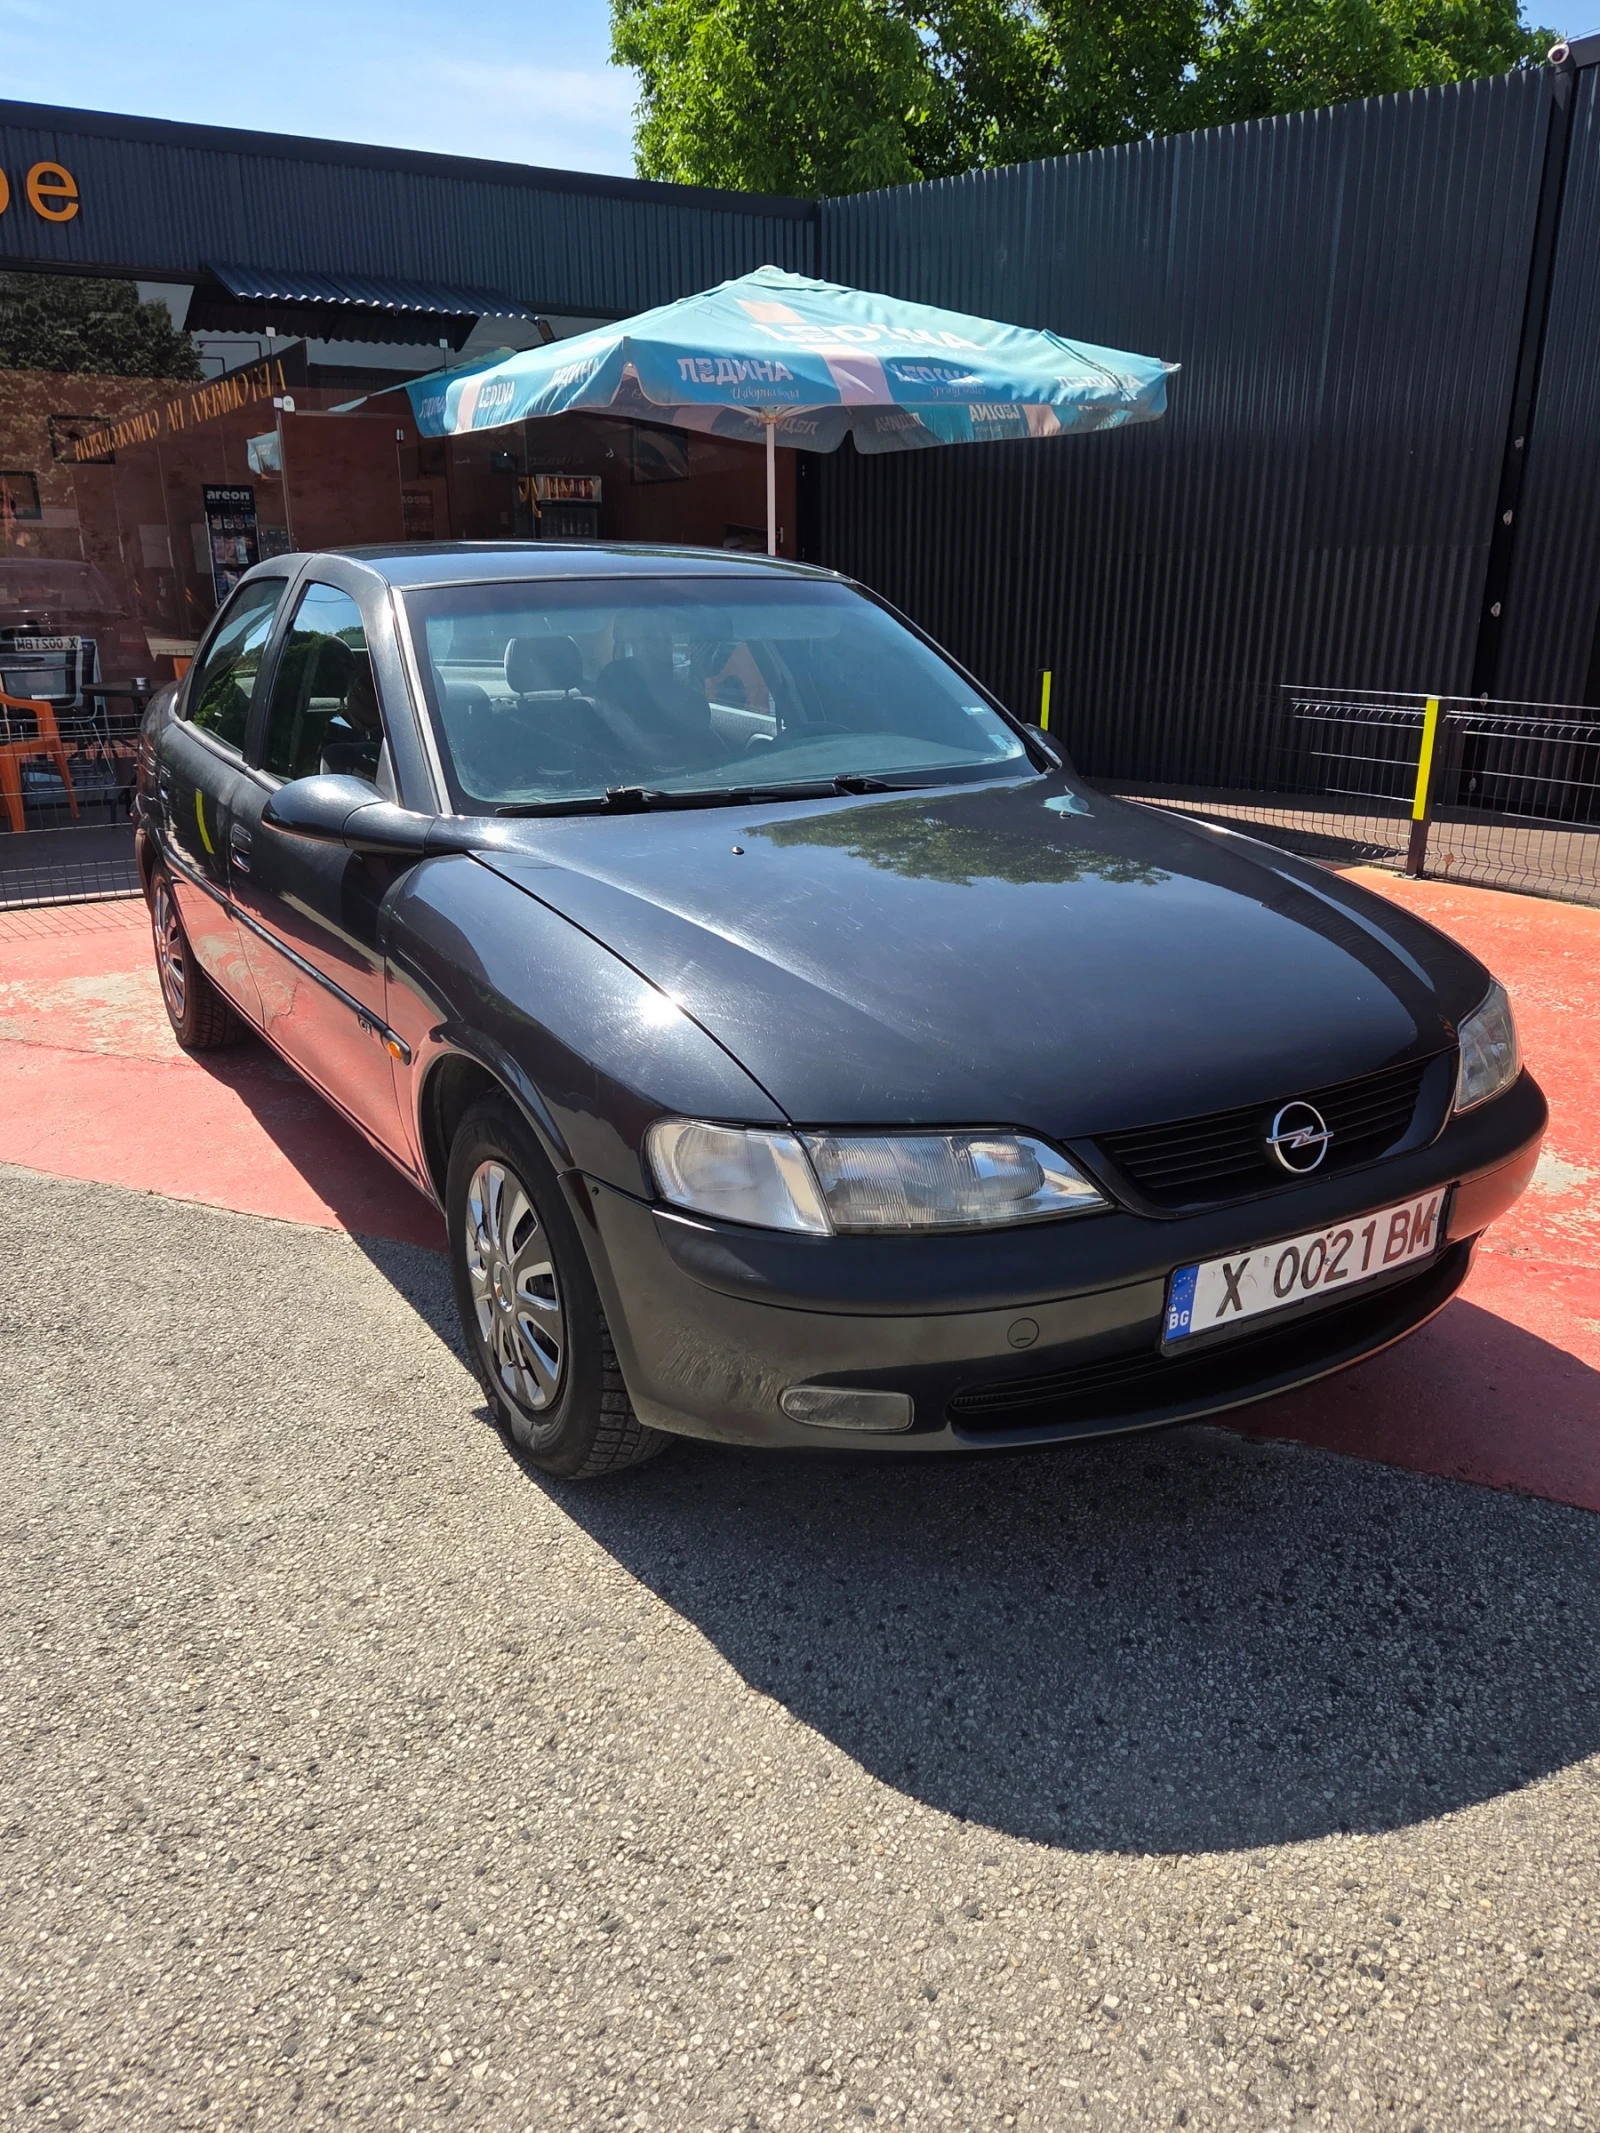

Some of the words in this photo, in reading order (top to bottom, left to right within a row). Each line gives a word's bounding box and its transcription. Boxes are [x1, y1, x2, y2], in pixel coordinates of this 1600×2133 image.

[0, 160, 79, 222] e
[750, 323, 987, 351] LEDINA
[677, 357, 794, 386] ЛЕДИНА
[478, 380, 515, 408] LEDINA
[930, 384, 961, 399] Spring
[206, 490, 250, 501] areon
[1273, 1220, 1377, 1298] 0021
[1382, 1197, 1438, 1264] BM
[1168, 1311, 1190, 1331] BG
